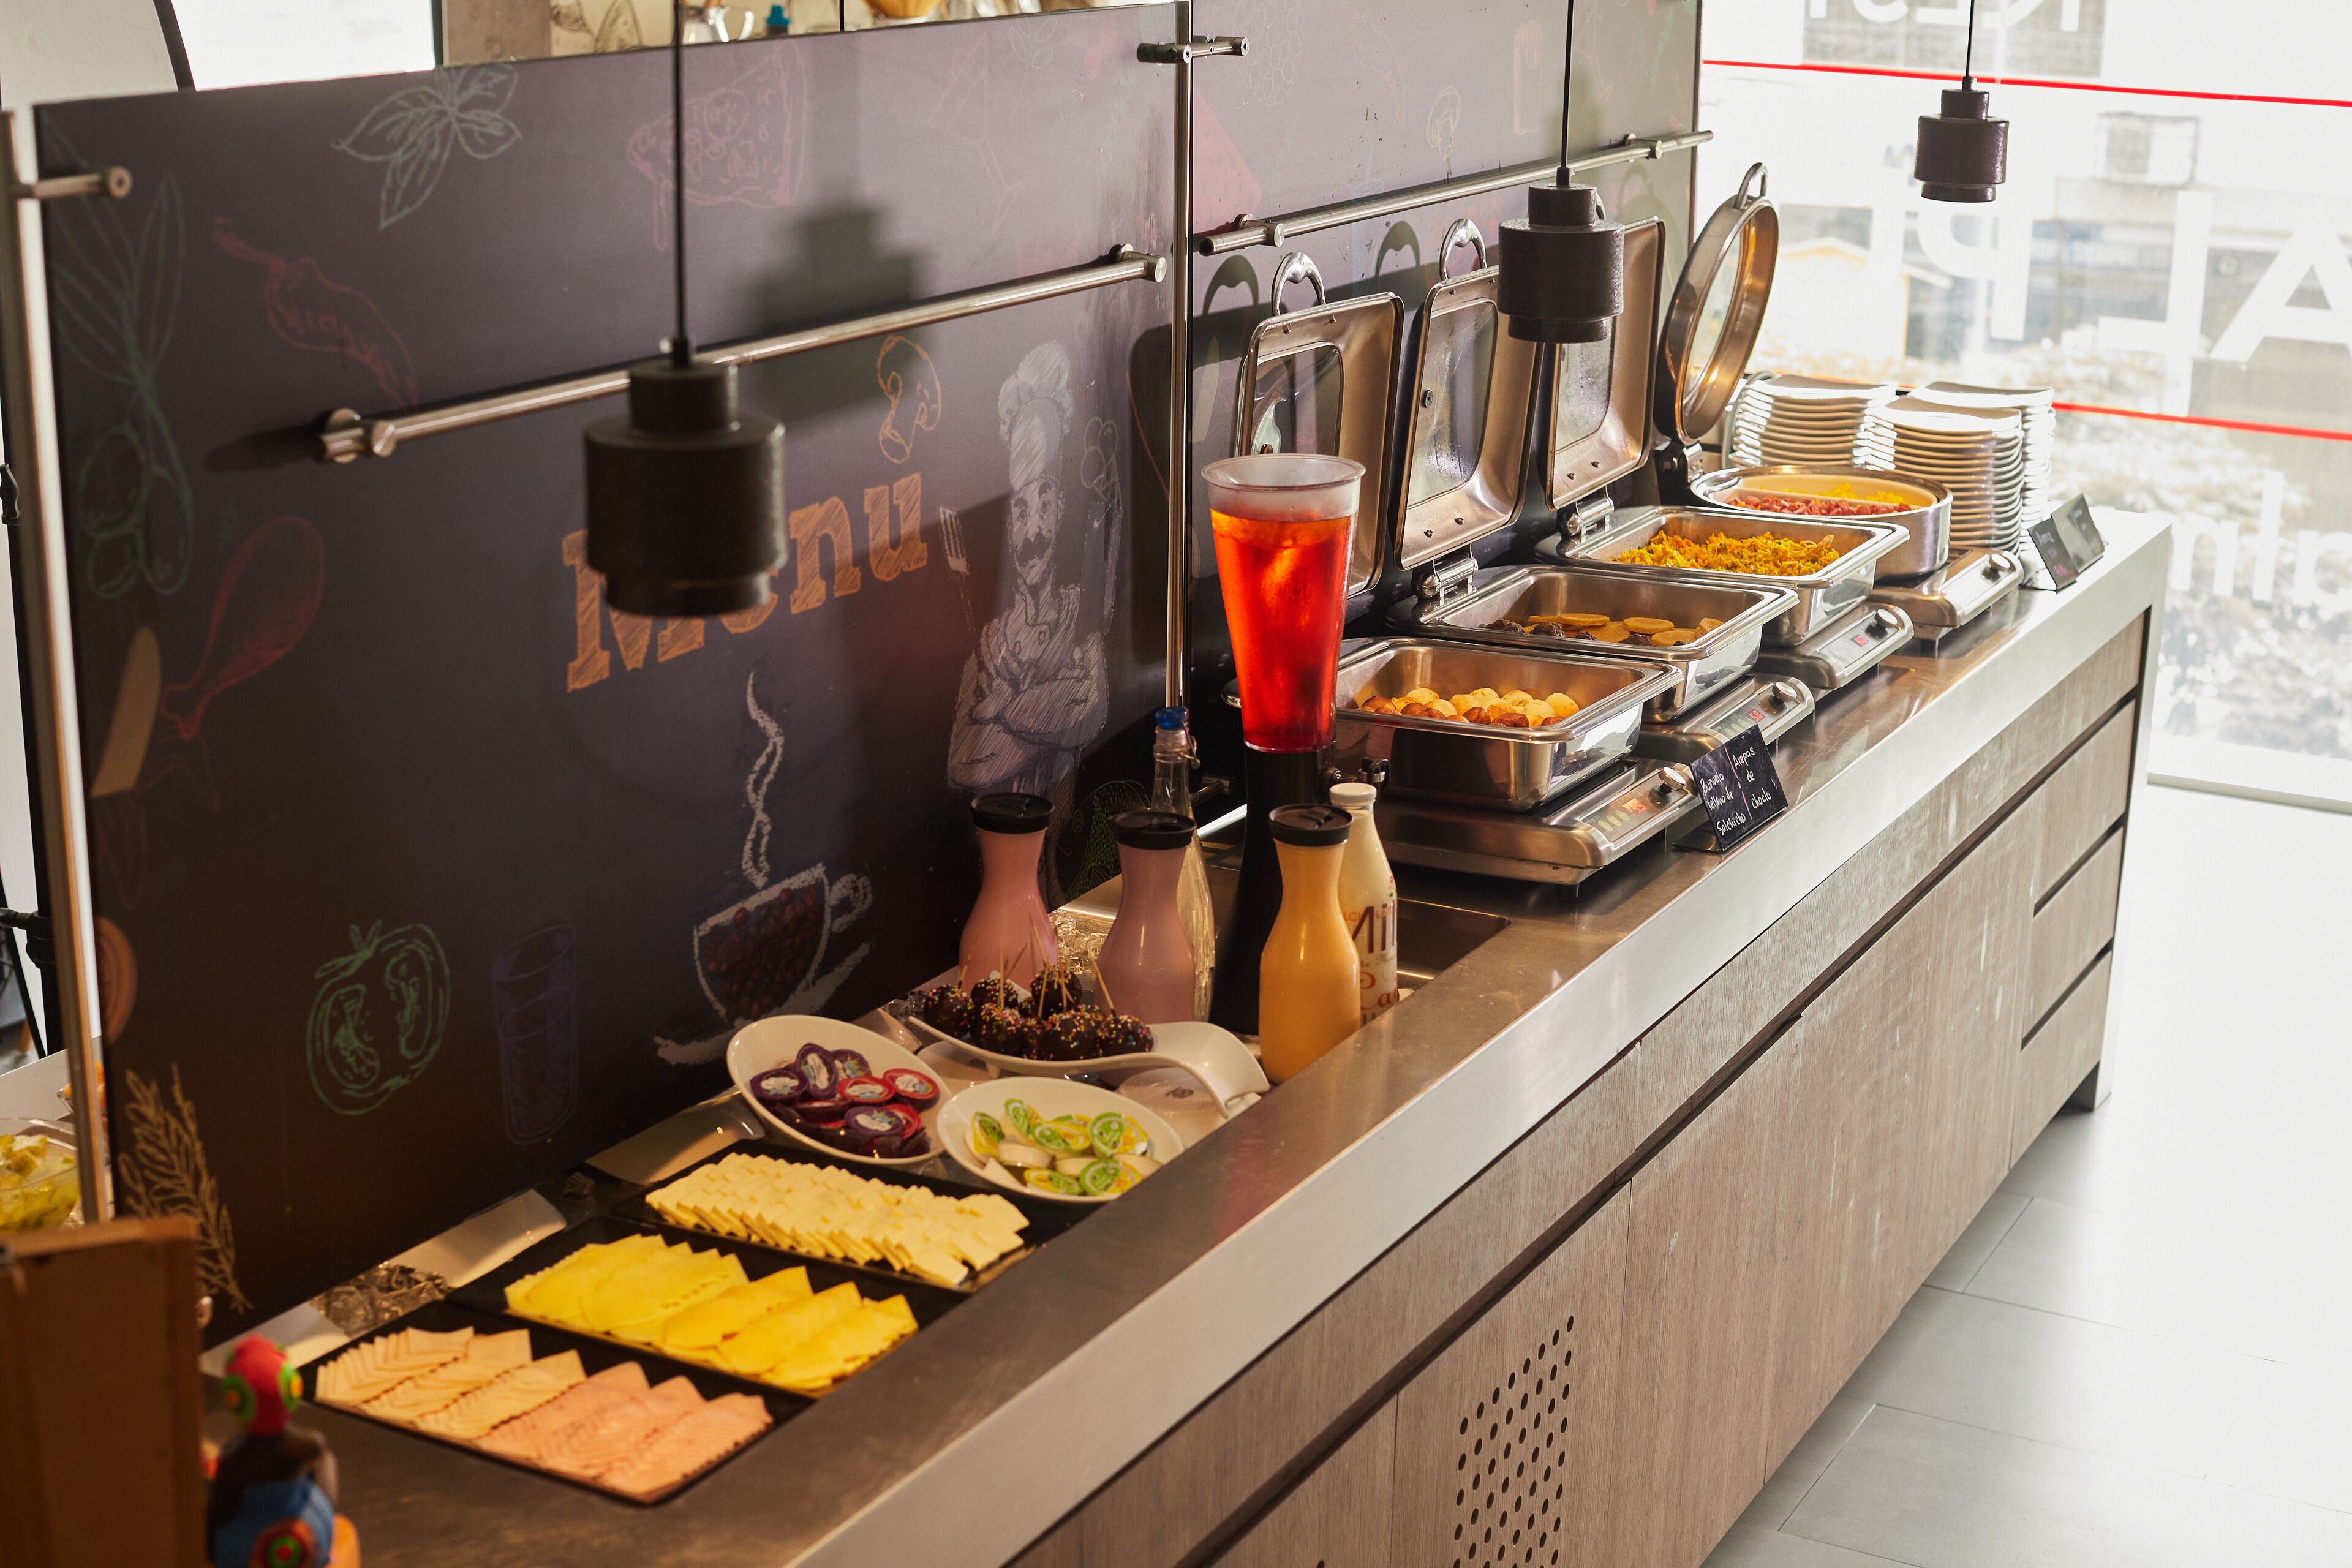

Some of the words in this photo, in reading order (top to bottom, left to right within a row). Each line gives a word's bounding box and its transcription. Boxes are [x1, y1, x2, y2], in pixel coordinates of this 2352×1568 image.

[561, 472, 928, 693] Mnu
[1749, 710, 1763, 722] 50
[1732, 747, 1755, 769] Arepas
[1746, 769, 1755, 782] de
[1725, 786, 1734, 801] de
